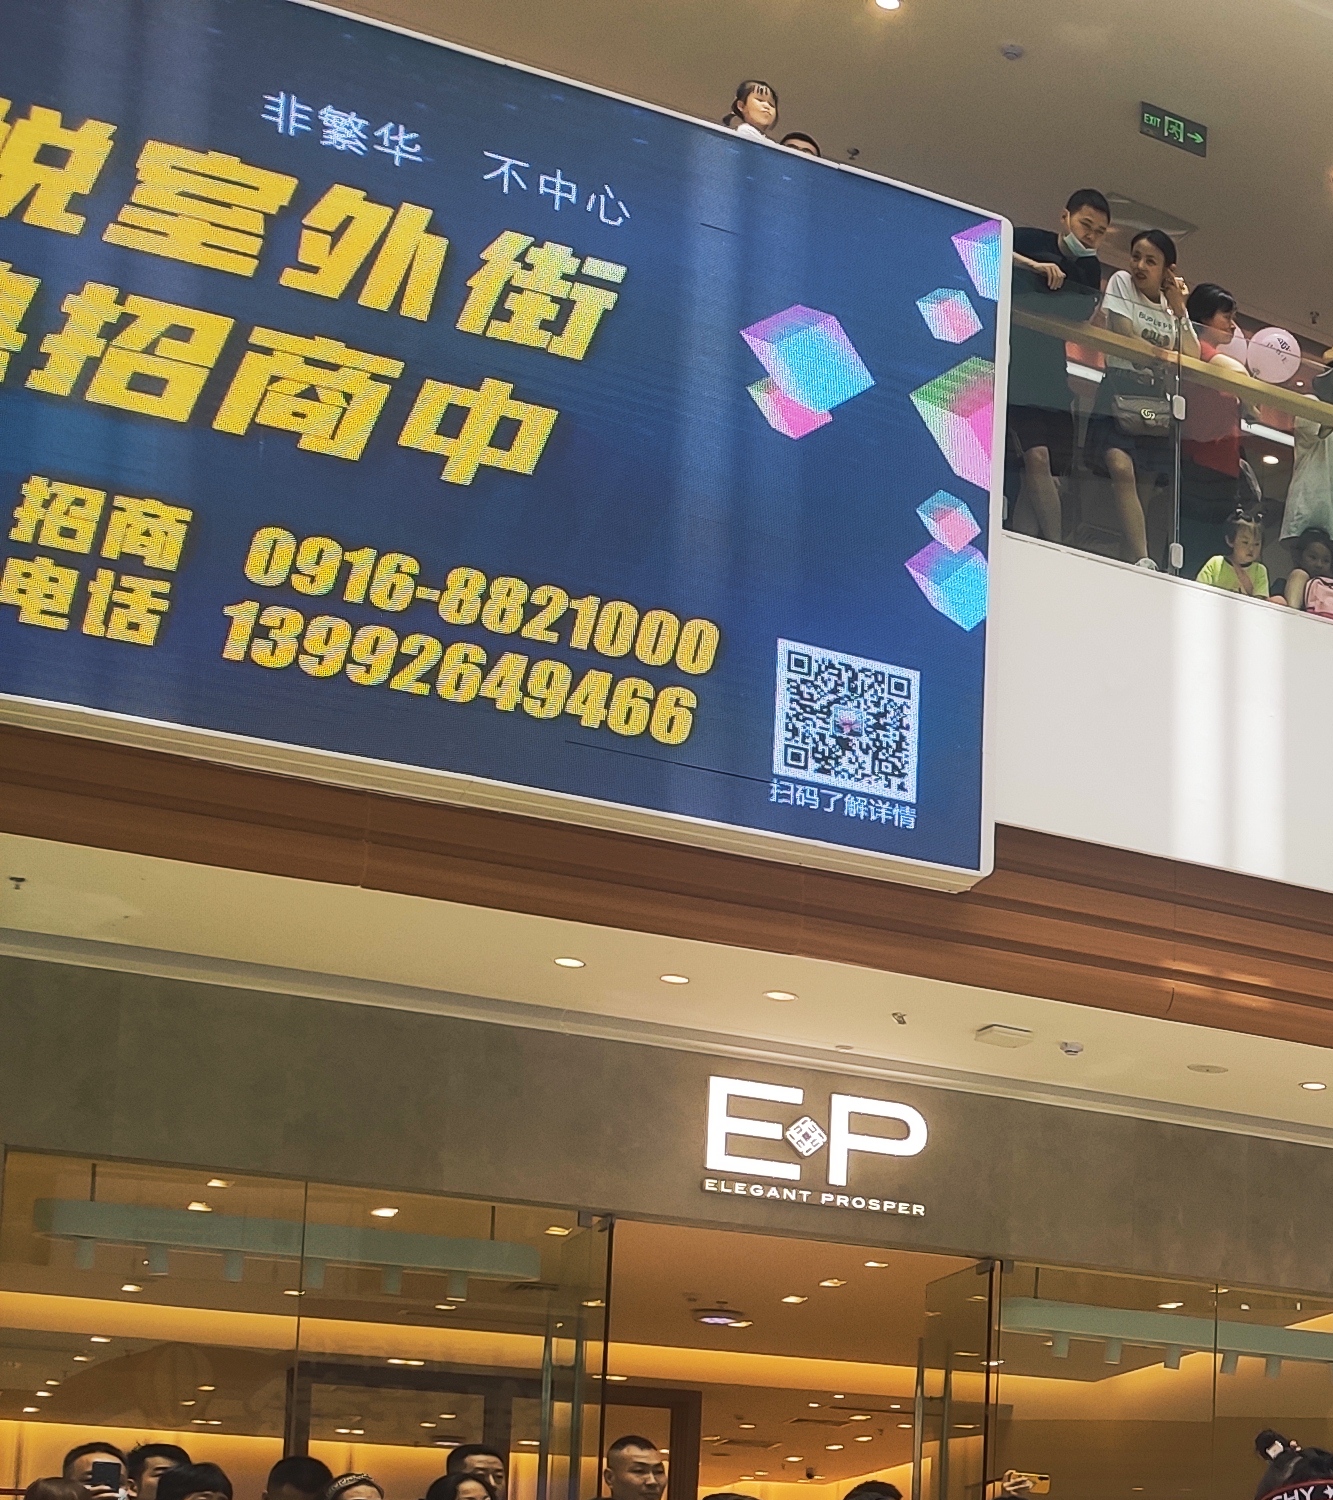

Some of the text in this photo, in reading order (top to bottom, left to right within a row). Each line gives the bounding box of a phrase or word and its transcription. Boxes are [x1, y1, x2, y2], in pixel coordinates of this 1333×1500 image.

[261, 91, 631, 227] 非繁华 不中心
[1143, 113, 1161, 128] EXIT
[8, 475, 194, 574] 招商
[2, 556, 173, 648] 电话
[244, 524, 722, 676] 0916-8821000
[221, 600, 699, 746] 13992649466
[769, 778, 917, 829] 扫码了解详情
[704, 1178, 926, 1216] ELEGANT PROSPER
